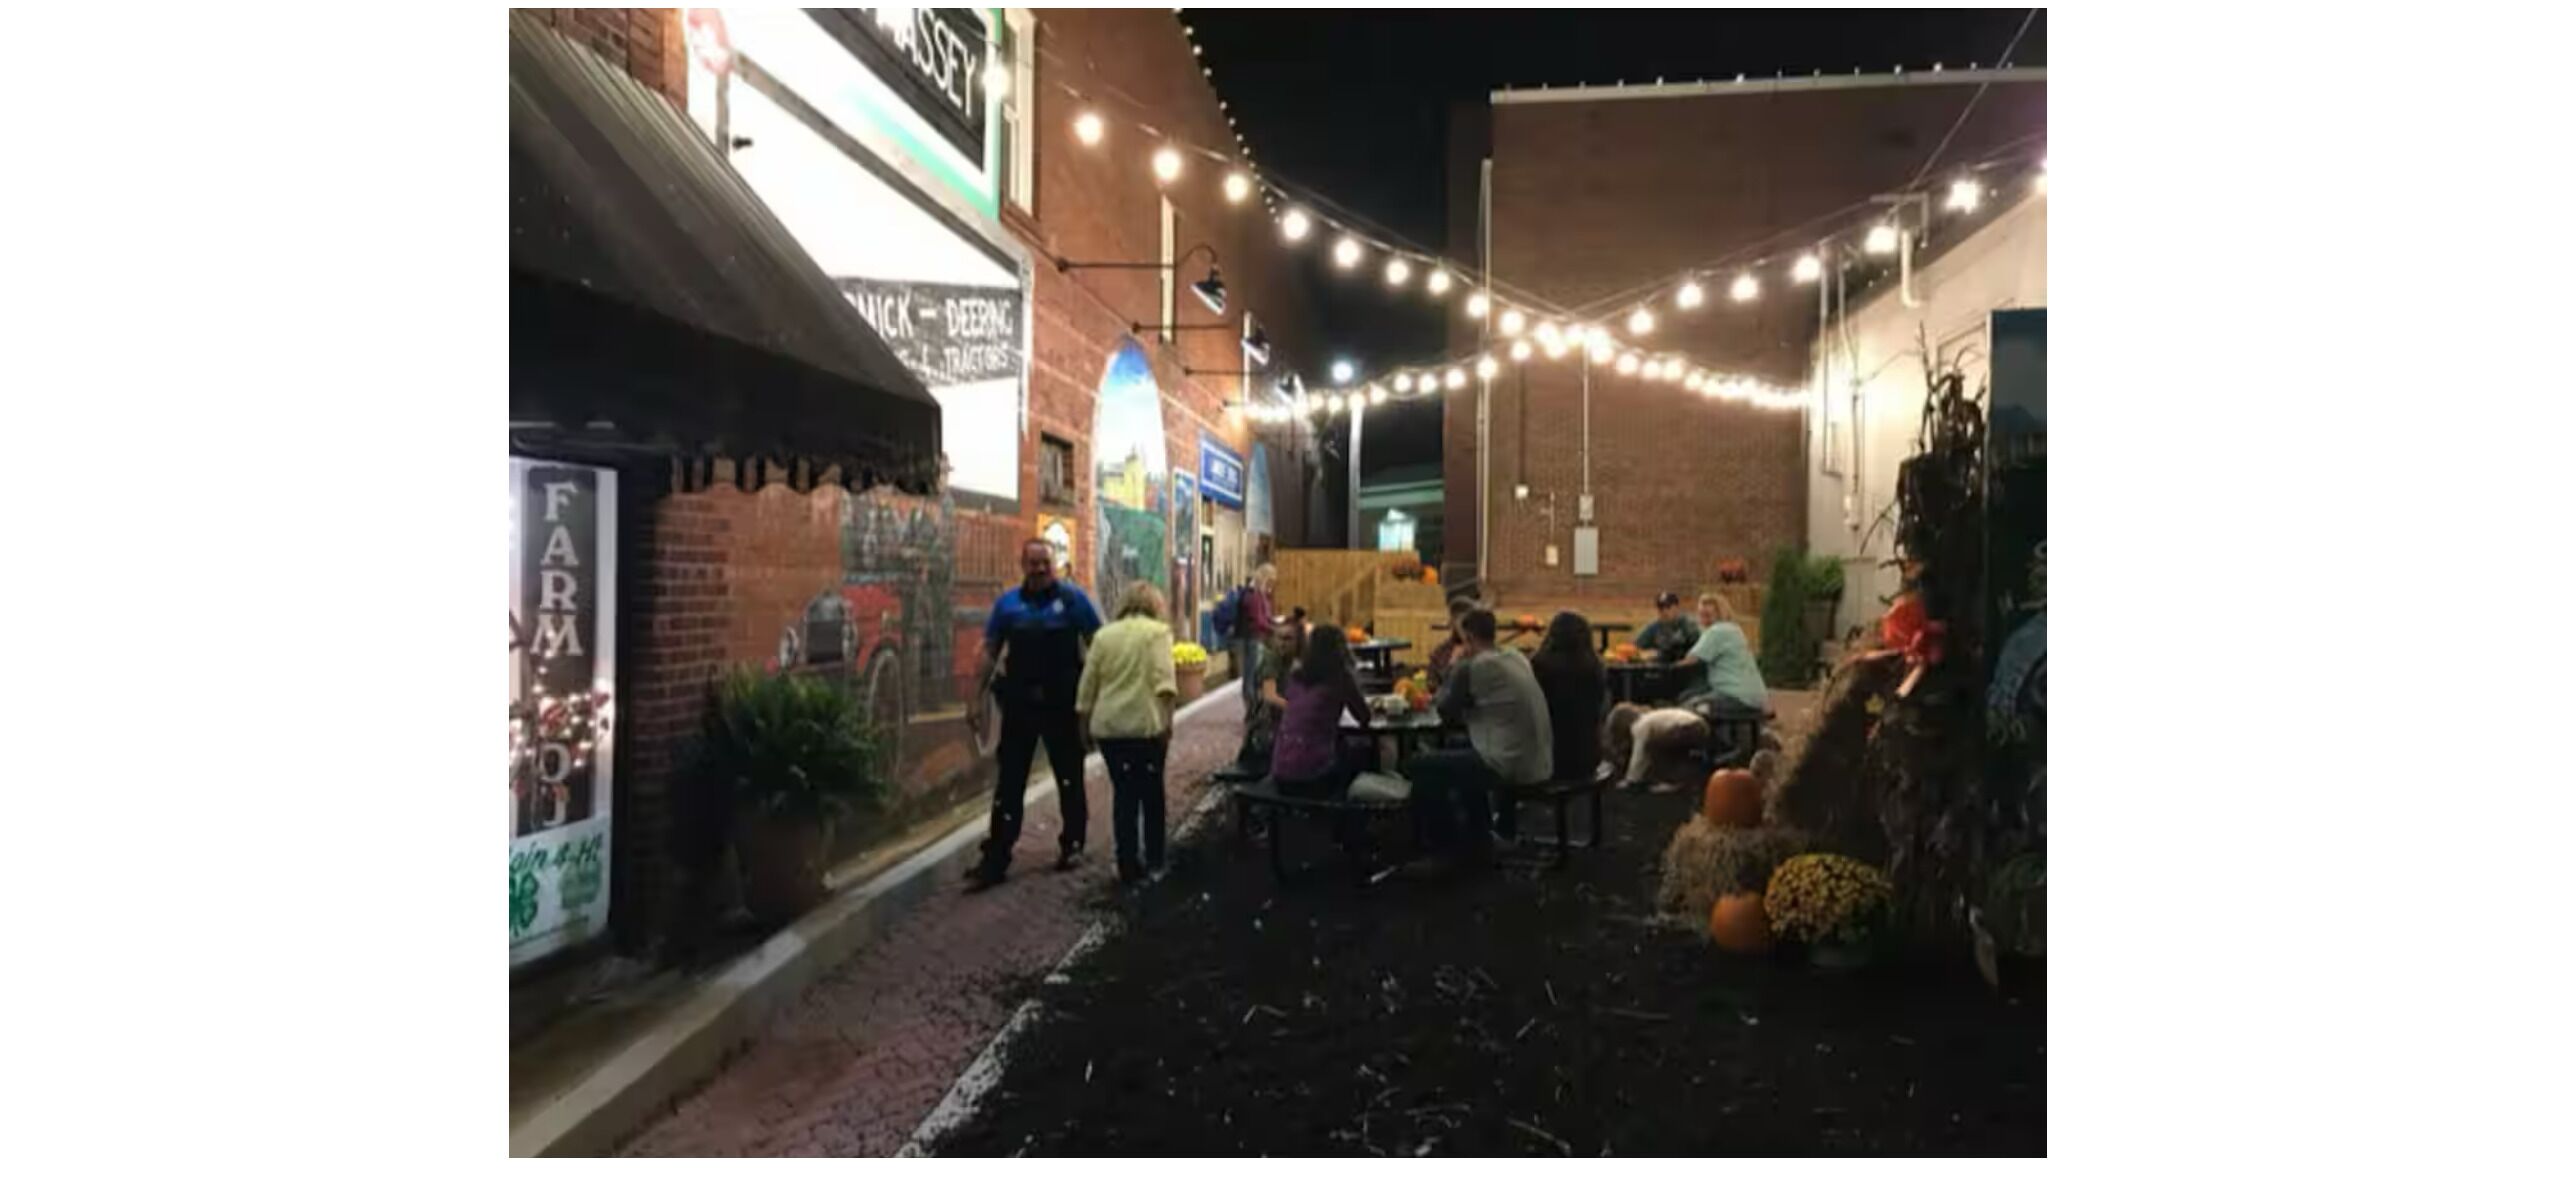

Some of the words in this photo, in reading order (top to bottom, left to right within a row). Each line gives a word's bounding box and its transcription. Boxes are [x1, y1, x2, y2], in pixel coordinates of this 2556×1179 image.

[843, 287, 914, 338] MICK
[529, 481, 583, 657] FARM
[509, 840, 548, 874] oin
